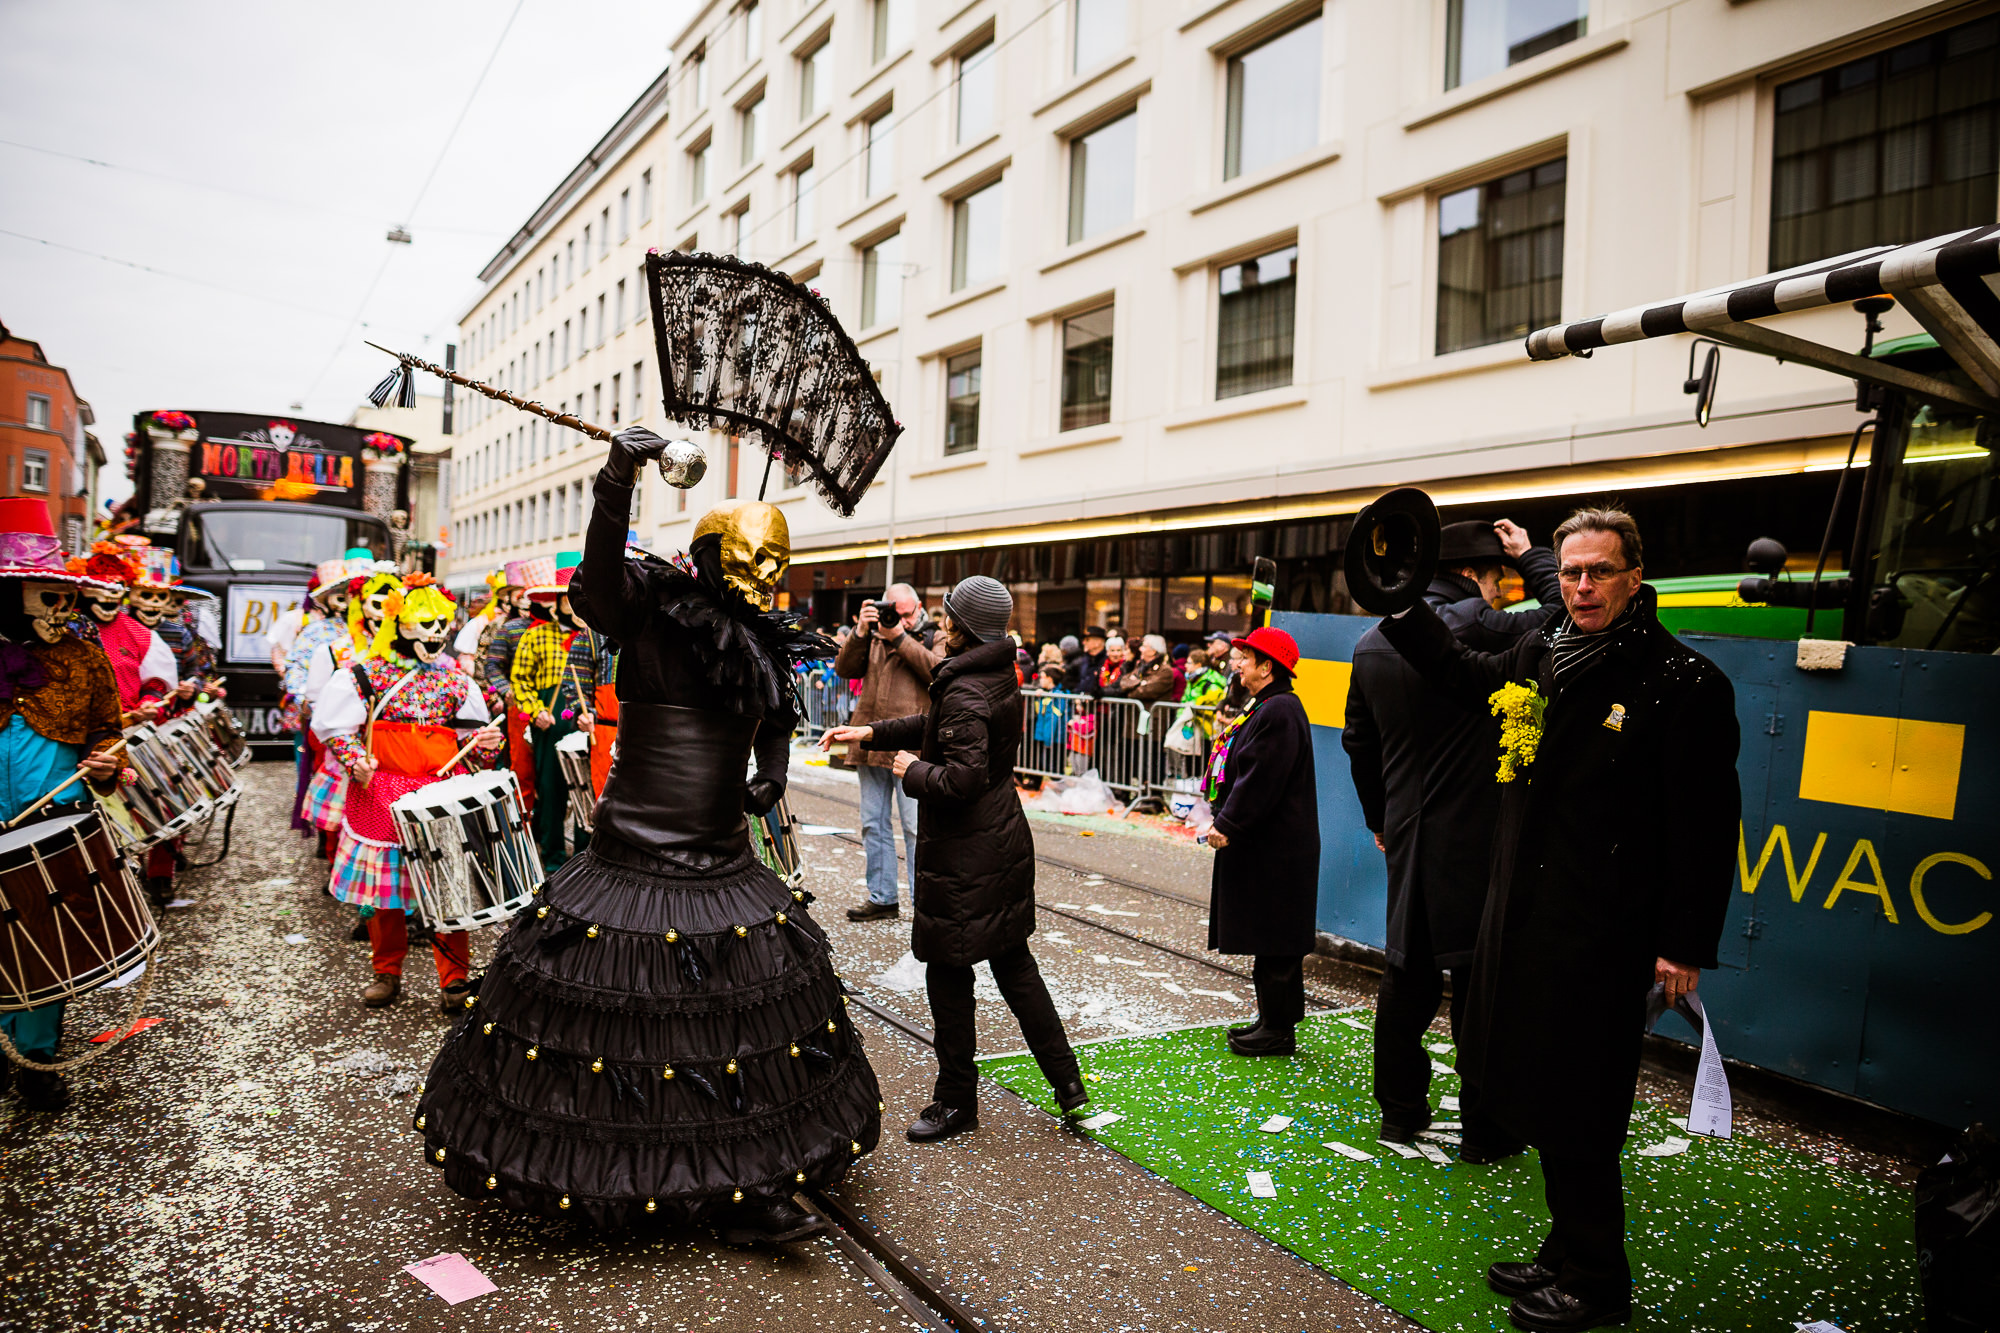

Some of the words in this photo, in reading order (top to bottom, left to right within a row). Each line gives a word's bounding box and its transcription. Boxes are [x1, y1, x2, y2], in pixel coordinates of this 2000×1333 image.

[201, 442, 282, 479] MORTA
[287, 451, 354, 488] BELLA
[1737, 818, 1994, 936] WAC
